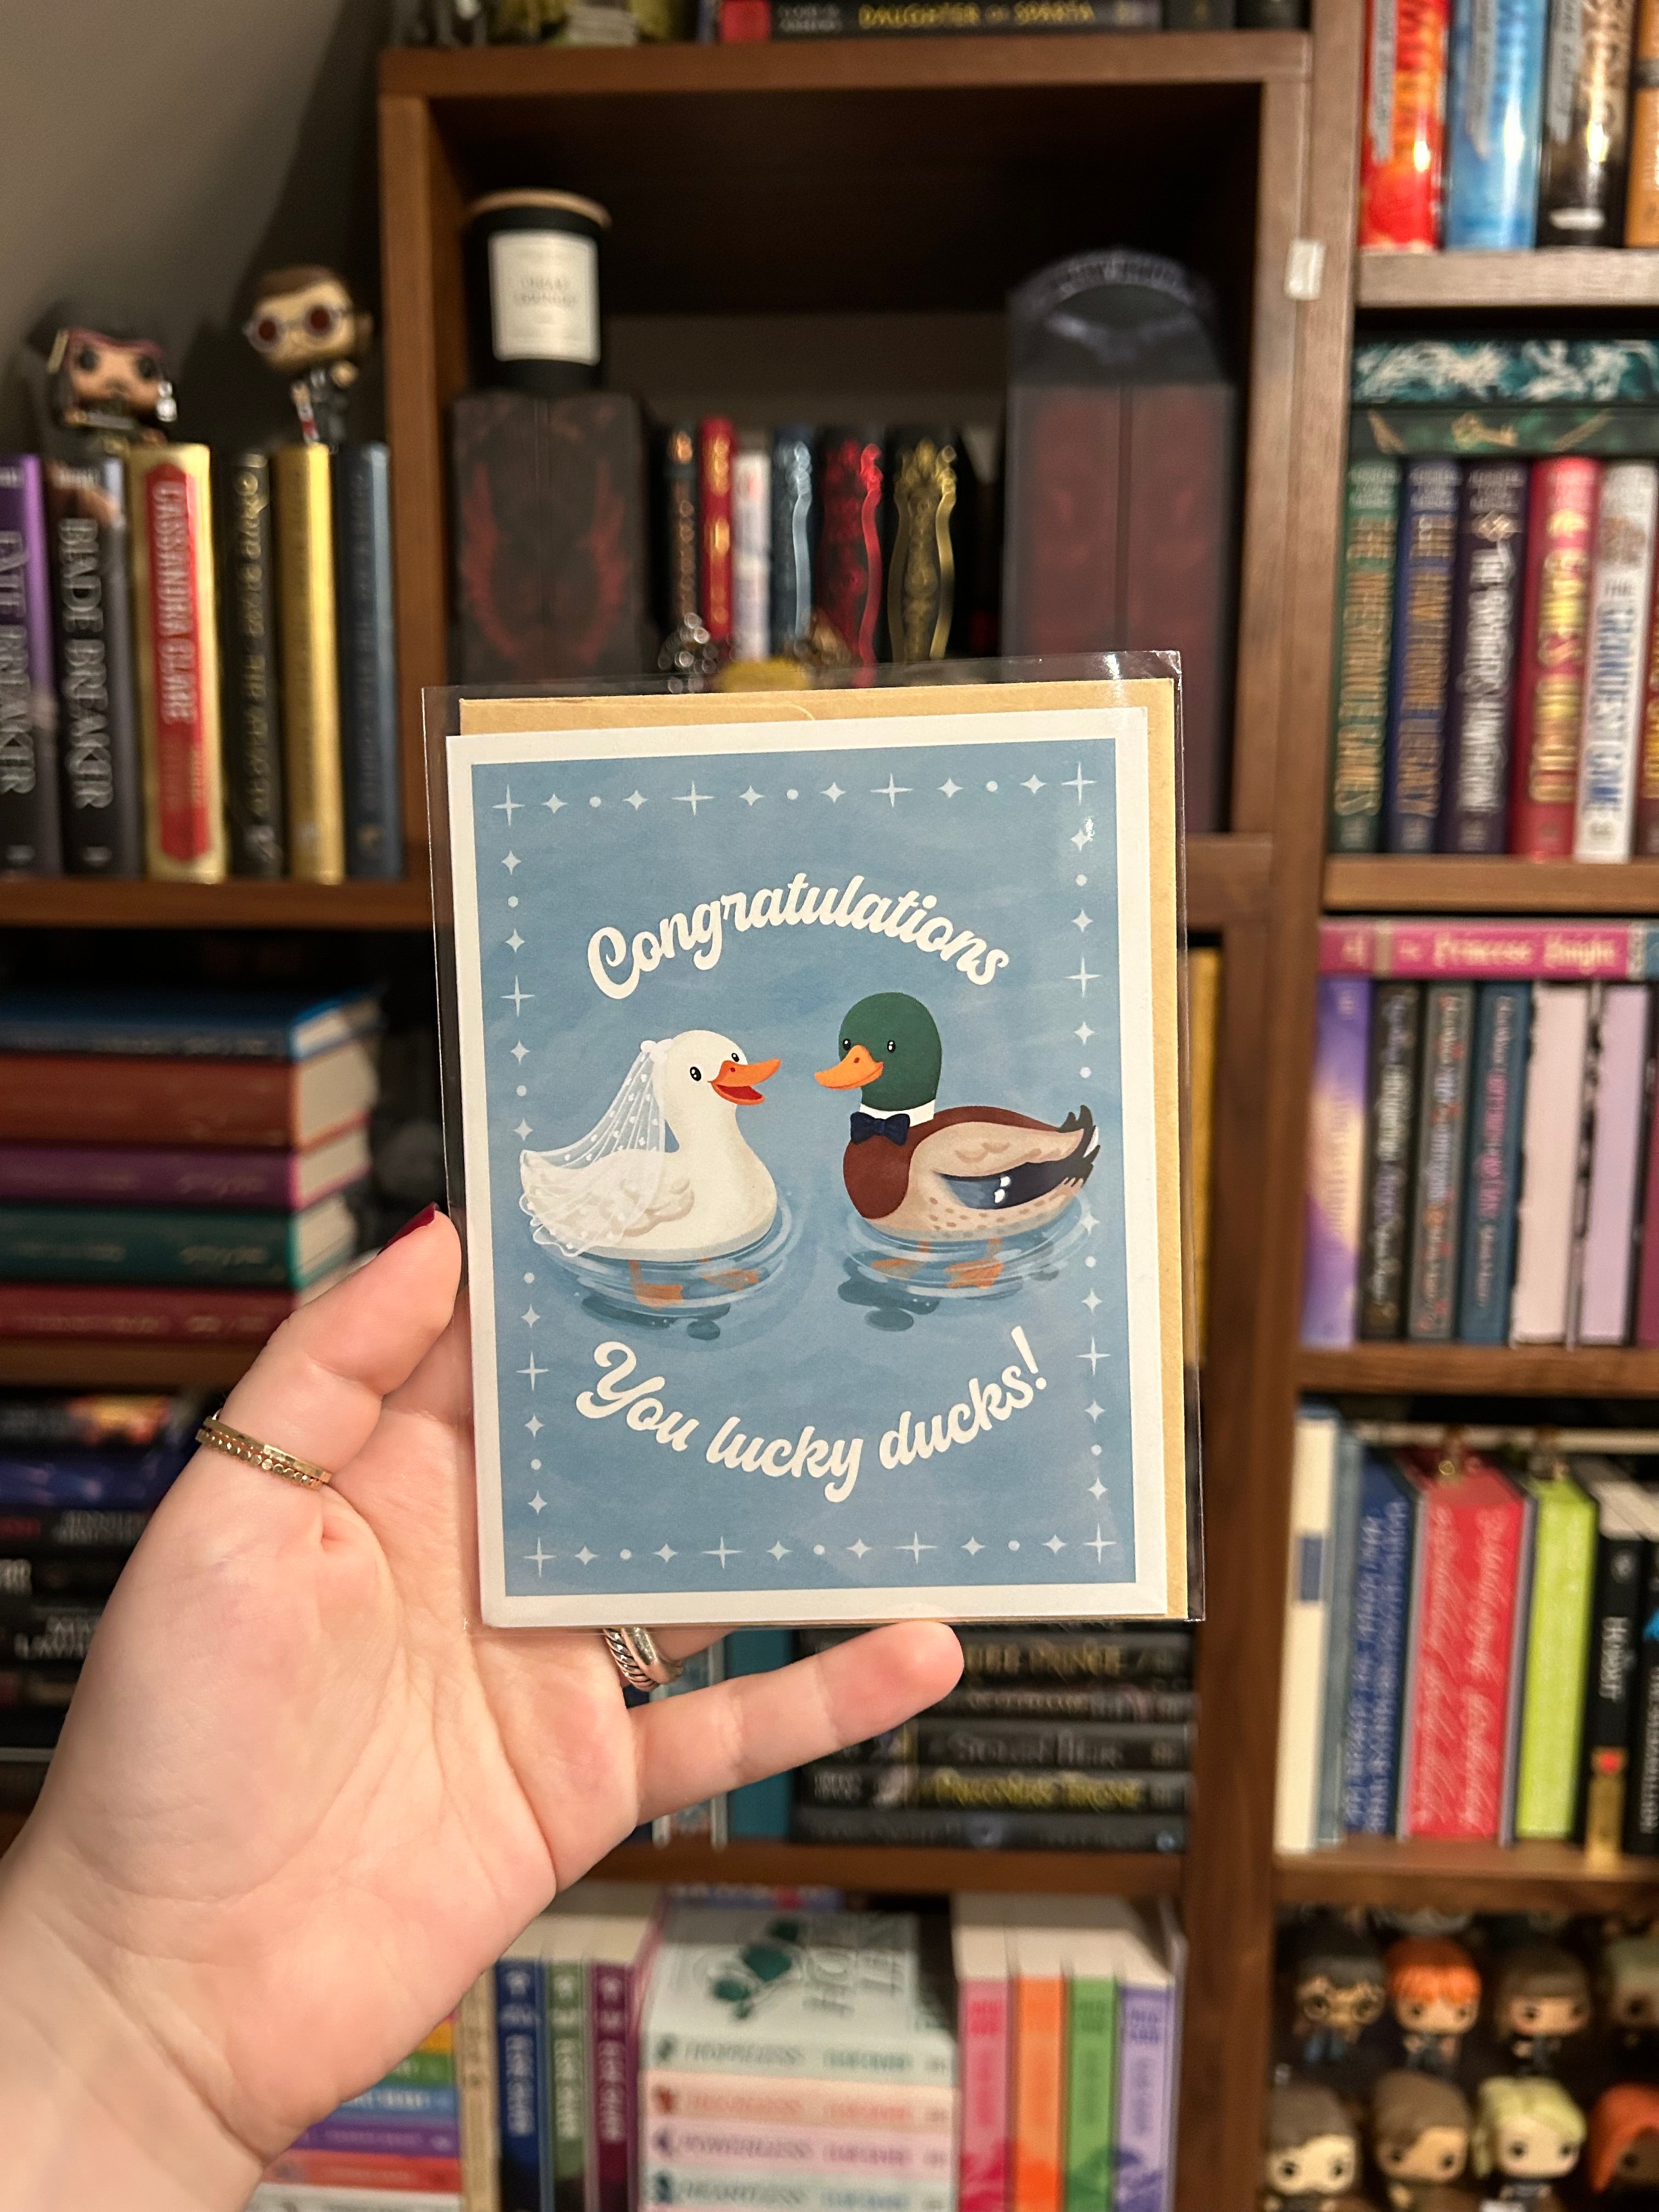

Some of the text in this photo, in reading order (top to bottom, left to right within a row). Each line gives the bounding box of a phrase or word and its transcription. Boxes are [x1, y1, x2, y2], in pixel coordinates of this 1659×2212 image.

[858, 3, 979, 27] DAUGHTER
[1014, 2, 1096, 25] SPARTA
[58, 518, 104, 634] BLADE
[153, 481, 191, 637] CASSANDRA
[63, 639, 114, 809] BREAKER
[159, 638, 197, 725] CLARE
[588, 873, 1009, 998] Congratulations
[576, 1326, 1047, 1502] You lucky ducks!
